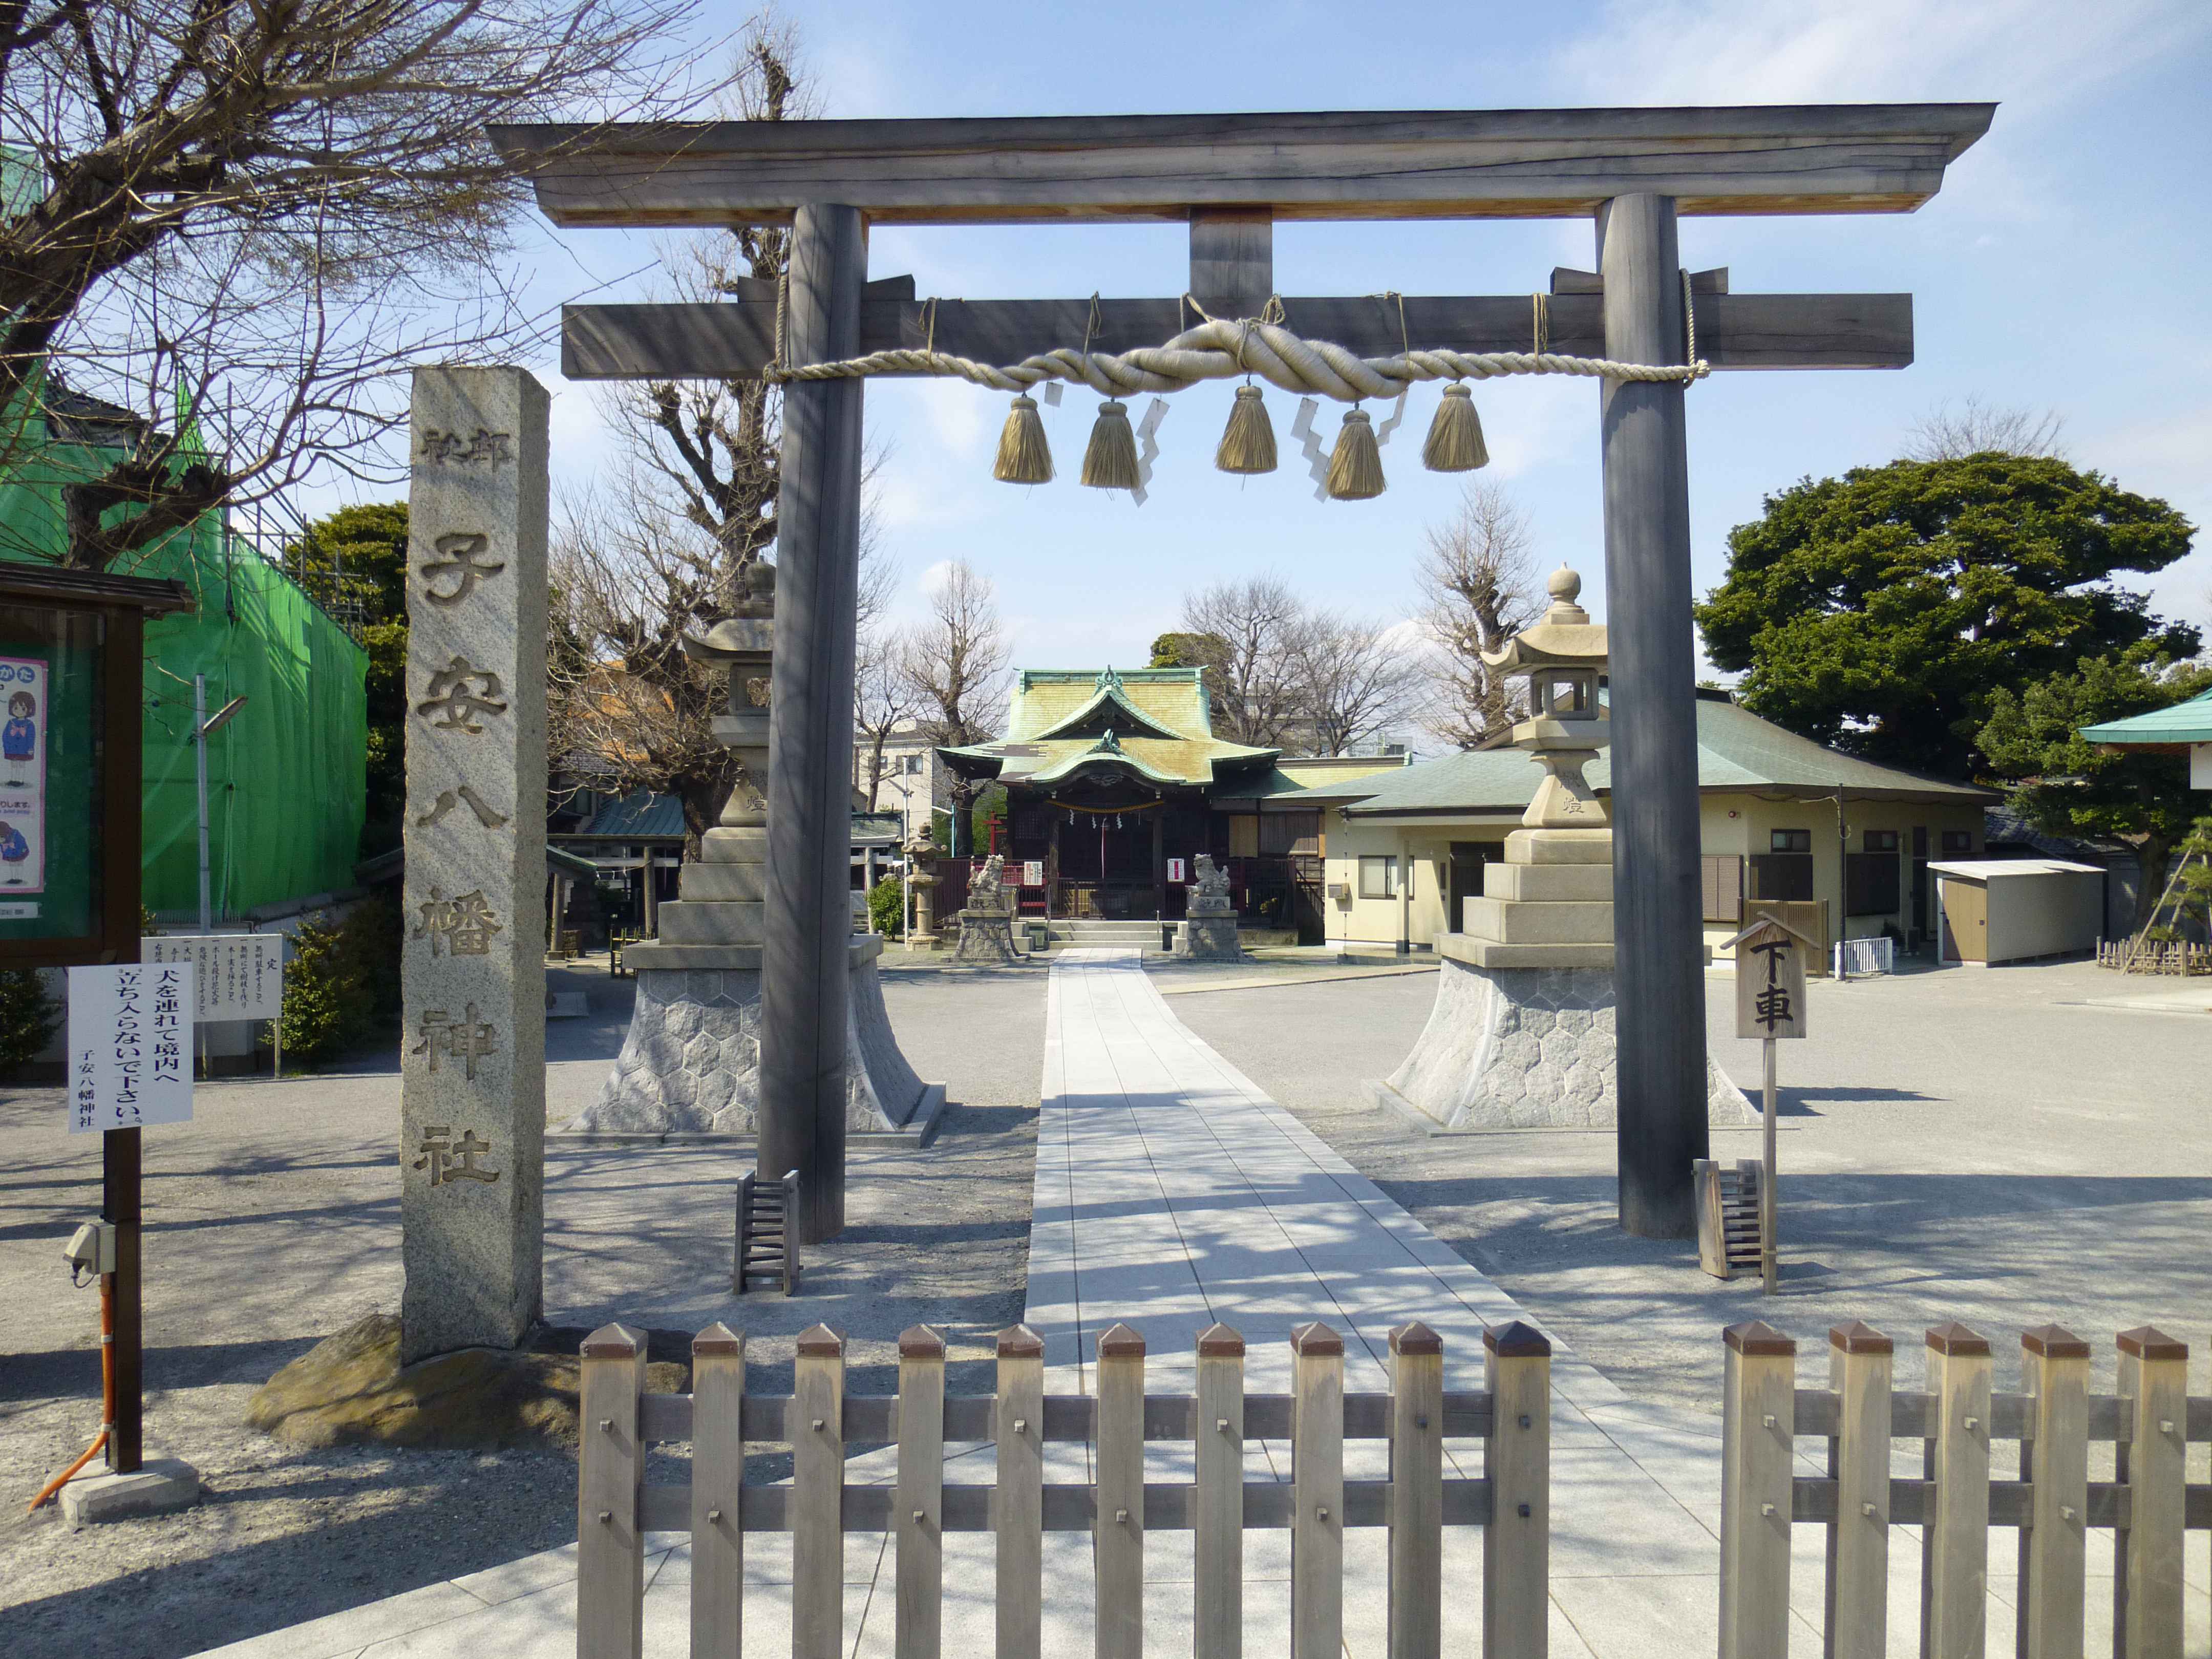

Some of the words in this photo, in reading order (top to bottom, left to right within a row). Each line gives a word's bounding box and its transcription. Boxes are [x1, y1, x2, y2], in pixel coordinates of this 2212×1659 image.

[412, 533, 509, 1186] 子安八幡神社
[267, 958, 278, 970] 定
[1750, 936, 1793, 1032] 下車
[114, 971, 143, 1123] 立ち入らないで下さい。
[154, 969, 180, 1082] 犬を連れて境内へ
[78, 1050, 95, 1128] 子安八幡神社
